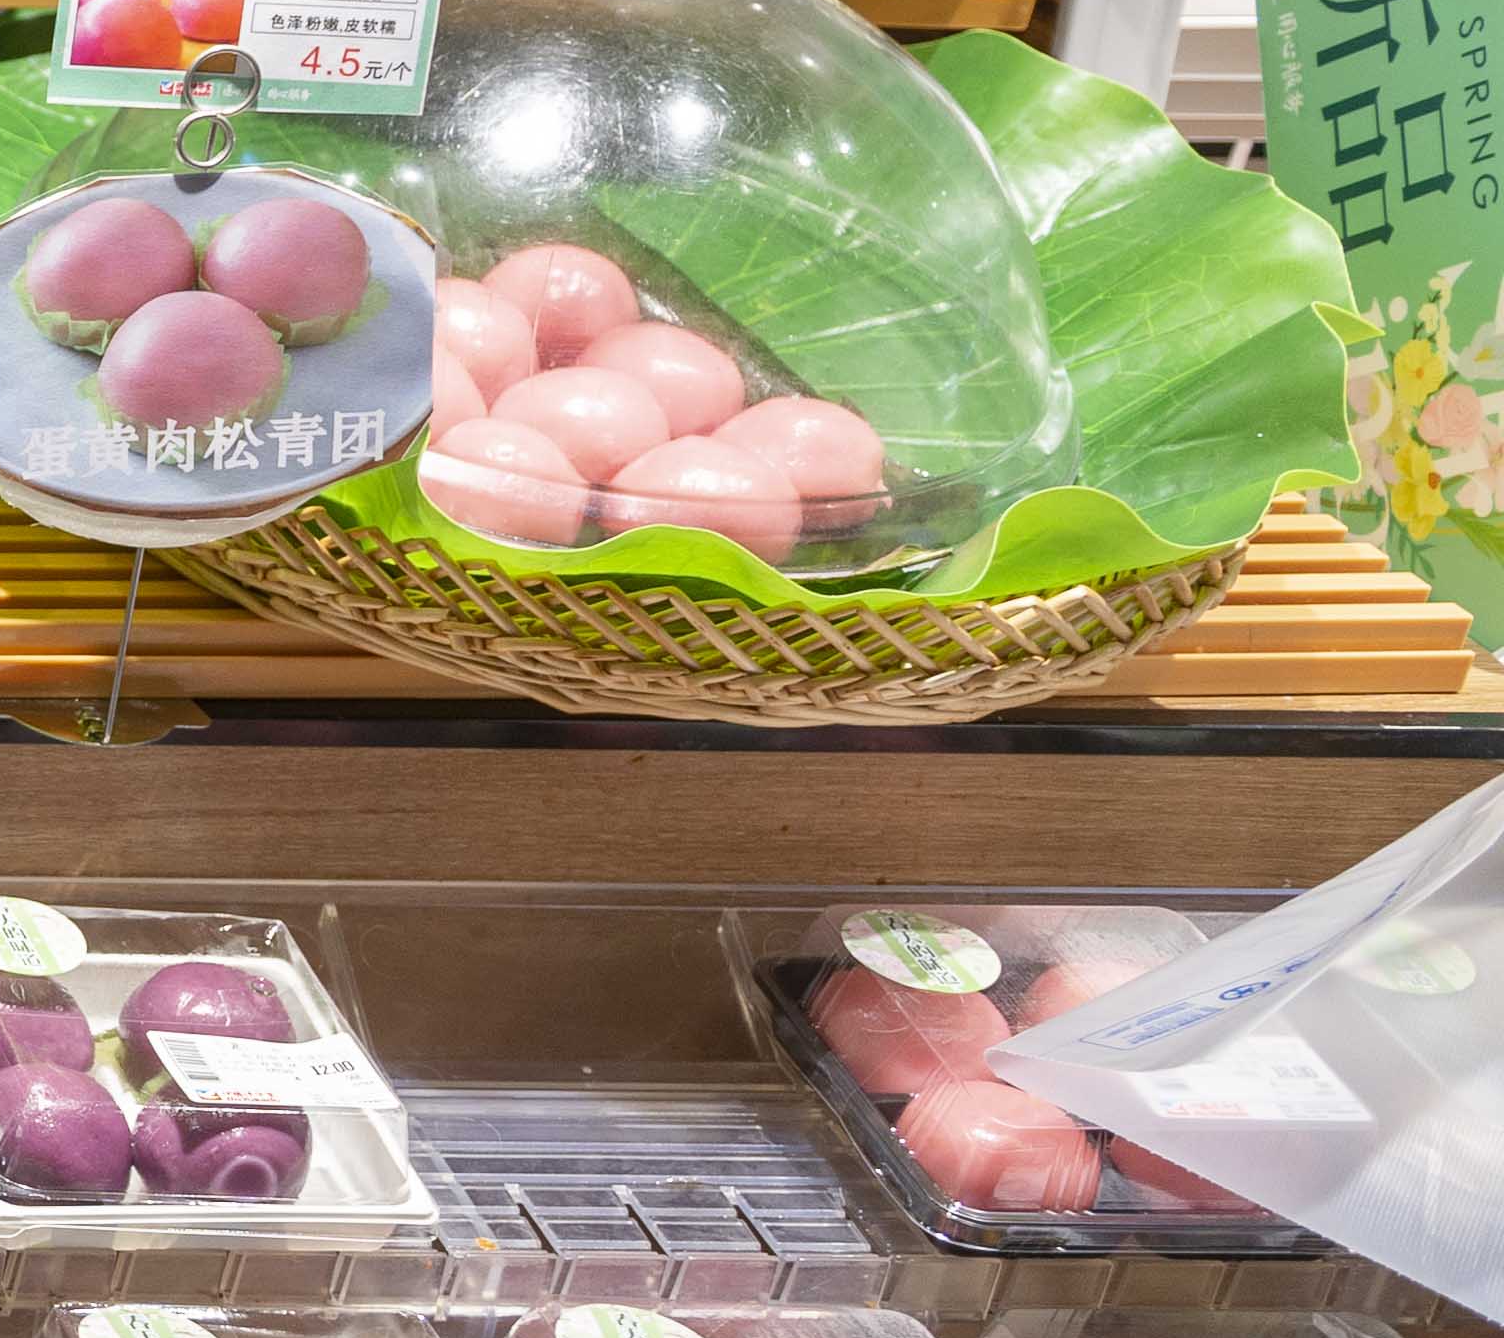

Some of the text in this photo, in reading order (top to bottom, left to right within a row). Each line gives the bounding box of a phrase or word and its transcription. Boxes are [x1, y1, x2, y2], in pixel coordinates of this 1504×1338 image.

[1459, 17, 1501, 211] SPRING
[20, 408, 387, 481] 蛋黄肉松青团
[311, 1060, 355, 1077] 12.00
